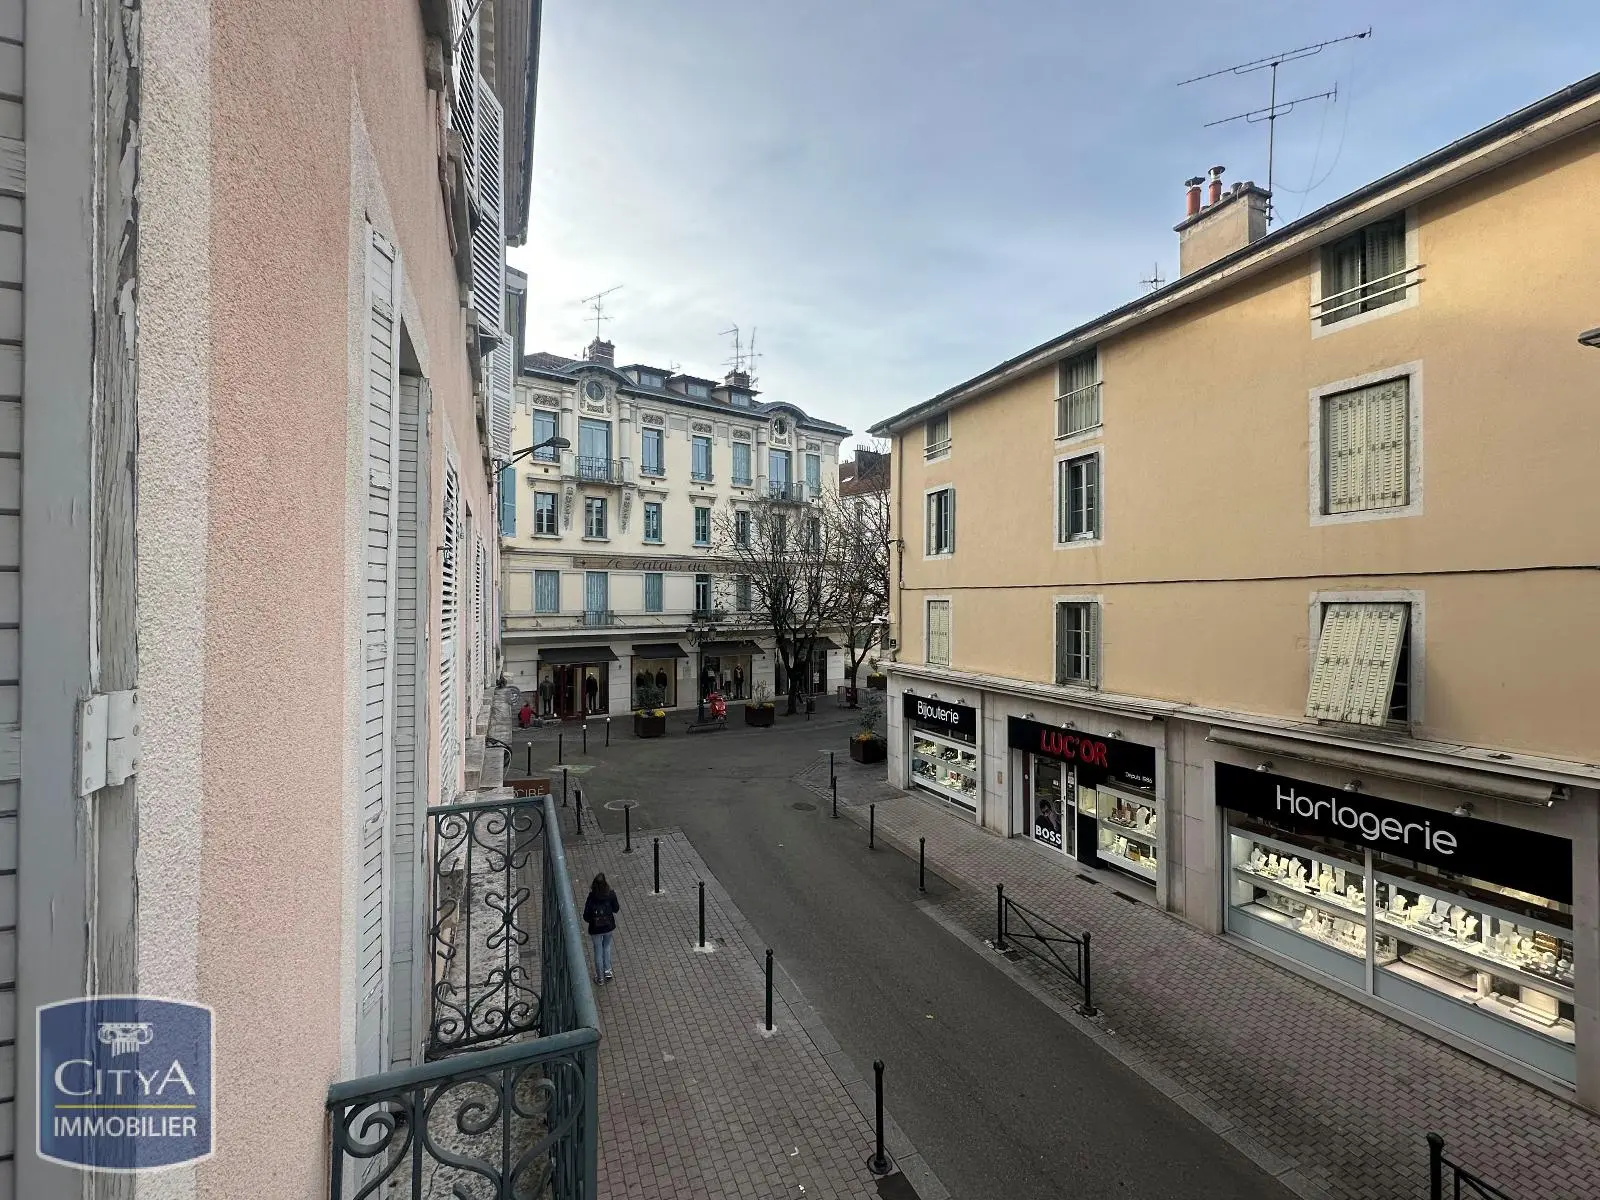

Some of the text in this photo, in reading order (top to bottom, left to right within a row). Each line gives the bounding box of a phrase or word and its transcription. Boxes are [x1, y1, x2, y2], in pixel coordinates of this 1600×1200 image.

[917, 700, 959, 724] Bijouterie
[1040, 729, 1108, 768] LUC'OR
[1035, 824, 1062, 845] BOSS
[1276, 784, 1458, 855] Horlogerie
